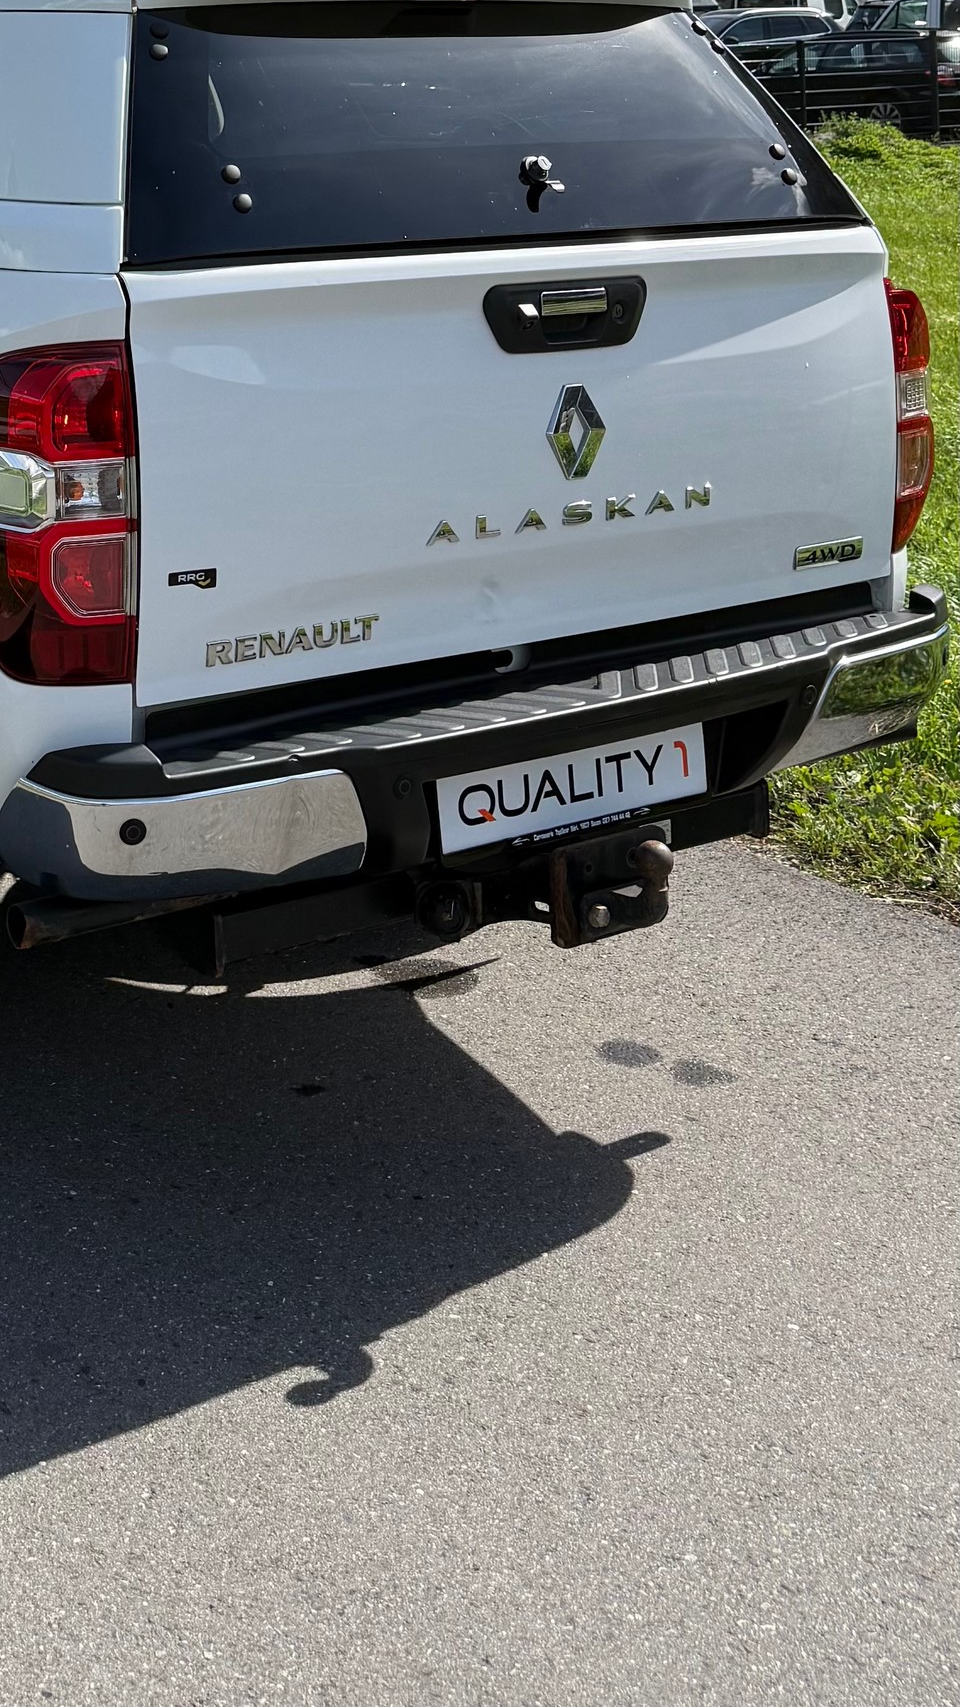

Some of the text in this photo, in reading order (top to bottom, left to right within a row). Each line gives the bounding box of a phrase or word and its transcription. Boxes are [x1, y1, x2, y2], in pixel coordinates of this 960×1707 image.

[425, 481, 713, 547] ALASKAN
[177, 572, 206, 583] RRG
[804, 543, 856, 563] 4WD
[205, 613, 380, 668] RENAULT
[457, 740, 689, 826] QUALITY 1
